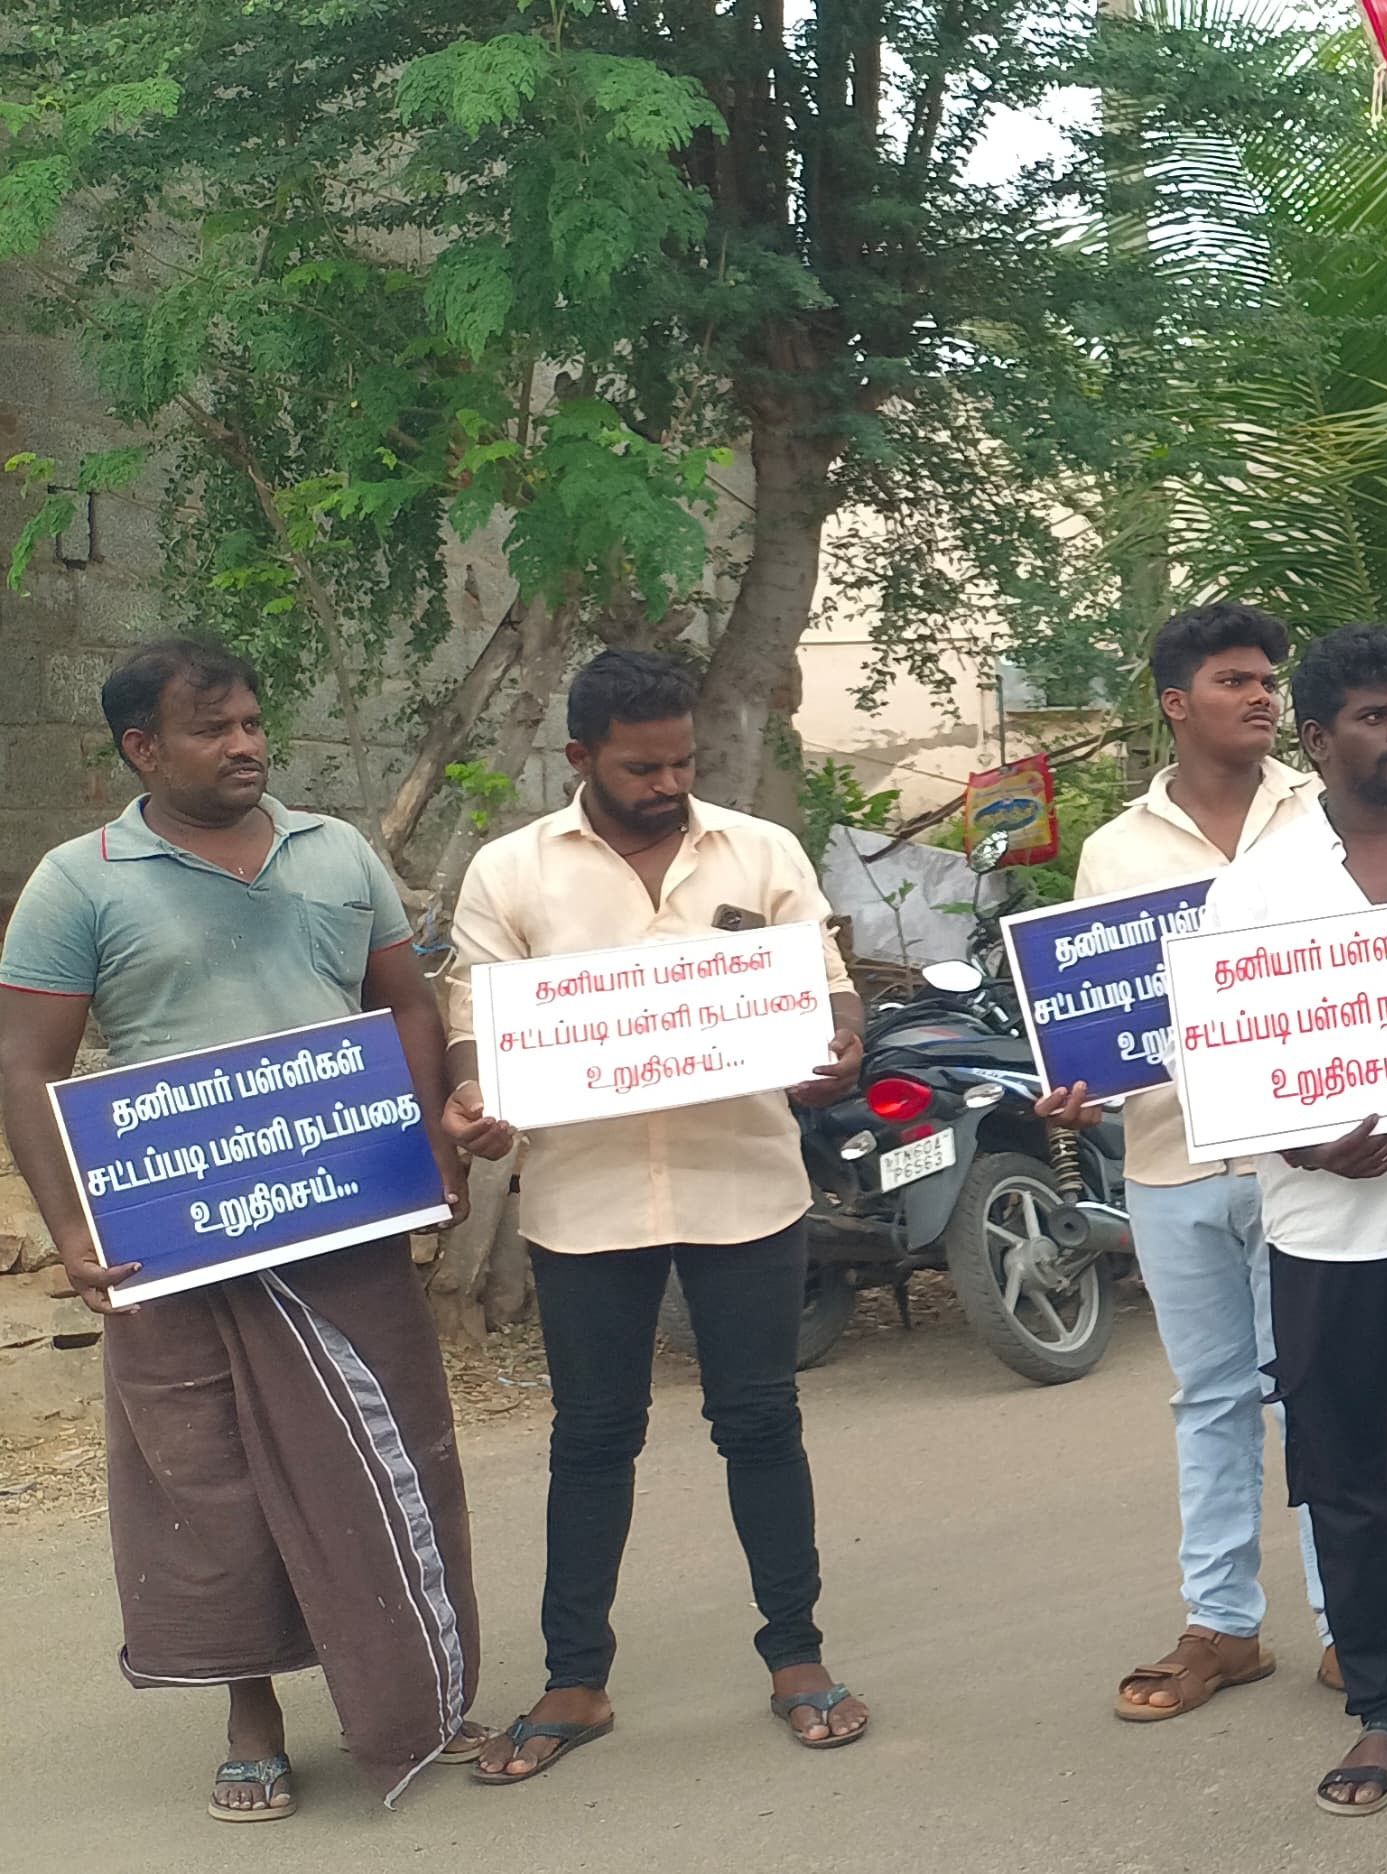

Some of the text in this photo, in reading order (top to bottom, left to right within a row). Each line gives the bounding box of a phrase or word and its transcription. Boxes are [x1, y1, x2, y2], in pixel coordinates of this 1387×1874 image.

[1054, 910, 1157, 972] தனியார்
[1216, 939, 1322, 991] தனியார்
[536, 946, 772, 1005] தனியார் பள்ளிகள்
[1034, 981, 1136, 1025] சட்டப்படி
[500, 991, 817, 1051] சட்டப்படி பள்ளி நடப்பதை
[1185, 1010, 1291, 1050] சட்டப்படி
[1298, 992, 1372, 1034] பள்ளி
[112, 1039, 364, 1138] தனியார் பள்ளிகள்
[587, 1046, 745, 1093] உறுதிசெய்...
[88, 1094, 420, 1196] சட்டப்படி பள்ளி நடப்பதை
[190, 1167, 357, 1236] உறுதிசெய்...
